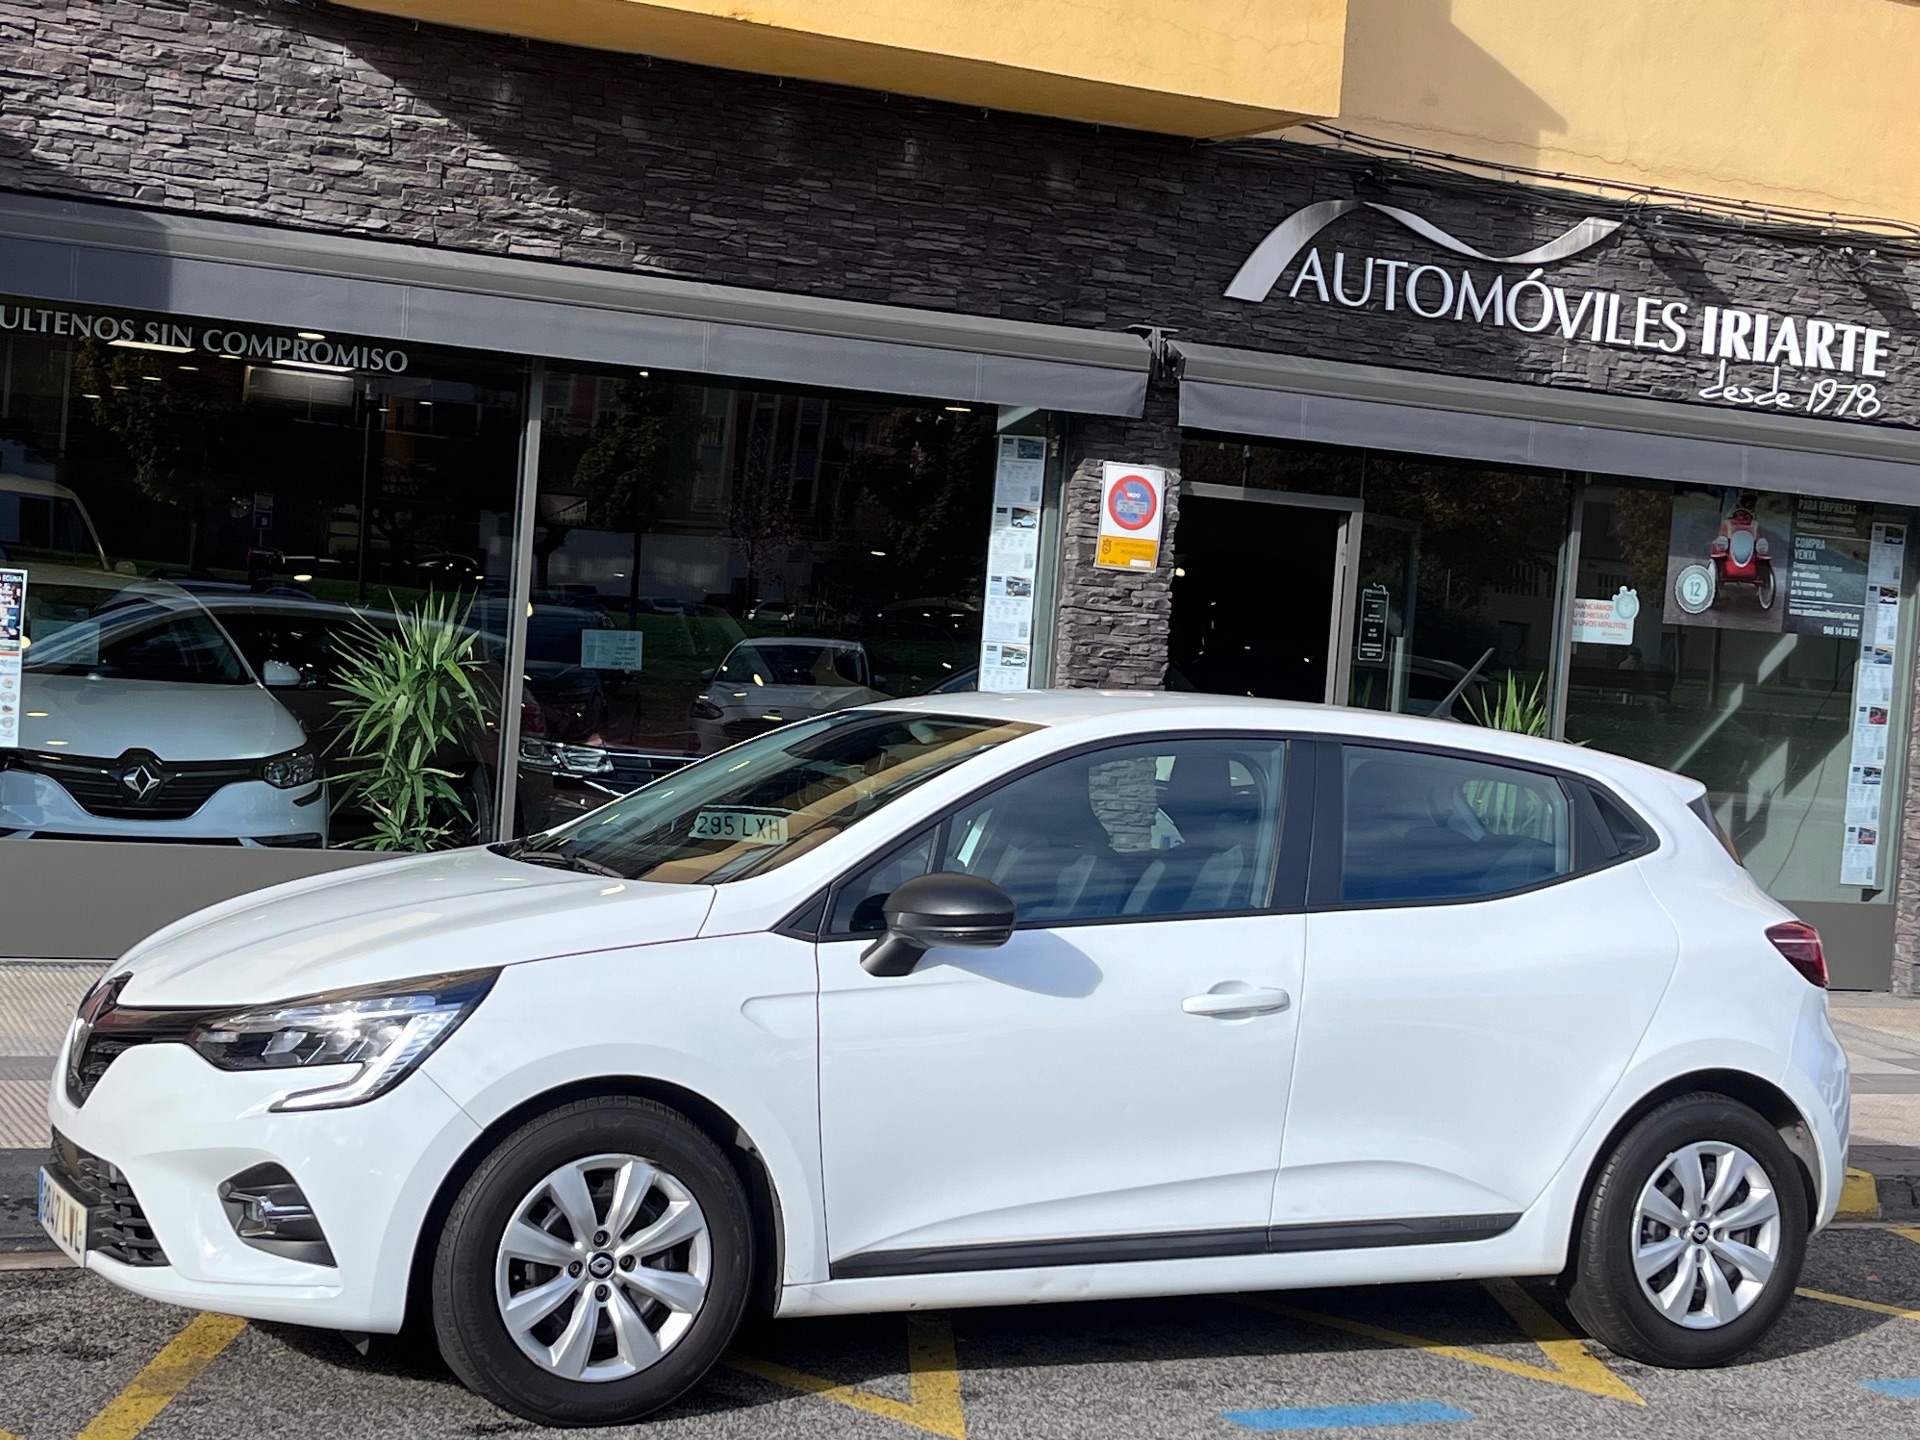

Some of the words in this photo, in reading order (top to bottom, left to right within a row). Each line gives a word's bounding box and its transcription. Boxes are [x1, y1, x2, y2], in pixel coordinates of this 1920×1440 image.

[1289, 247, 1688, 352] AUTOMÓVILES
[1701, 306, 1890, 378] IRIARTE
[145, 321, 193, 348] SIN
[203, 329, 408, 372] COMPROMISO
[1698, 358, 1795, 409] desde
[1806, 378, 1881, 418] 1978
[1794, 549, 1817, 561] VENTA
[1795, 537, 1826, 550] COMPRA
[1690, 581, 1701, 597] 12
[742, 817, 780, 841] LXH
